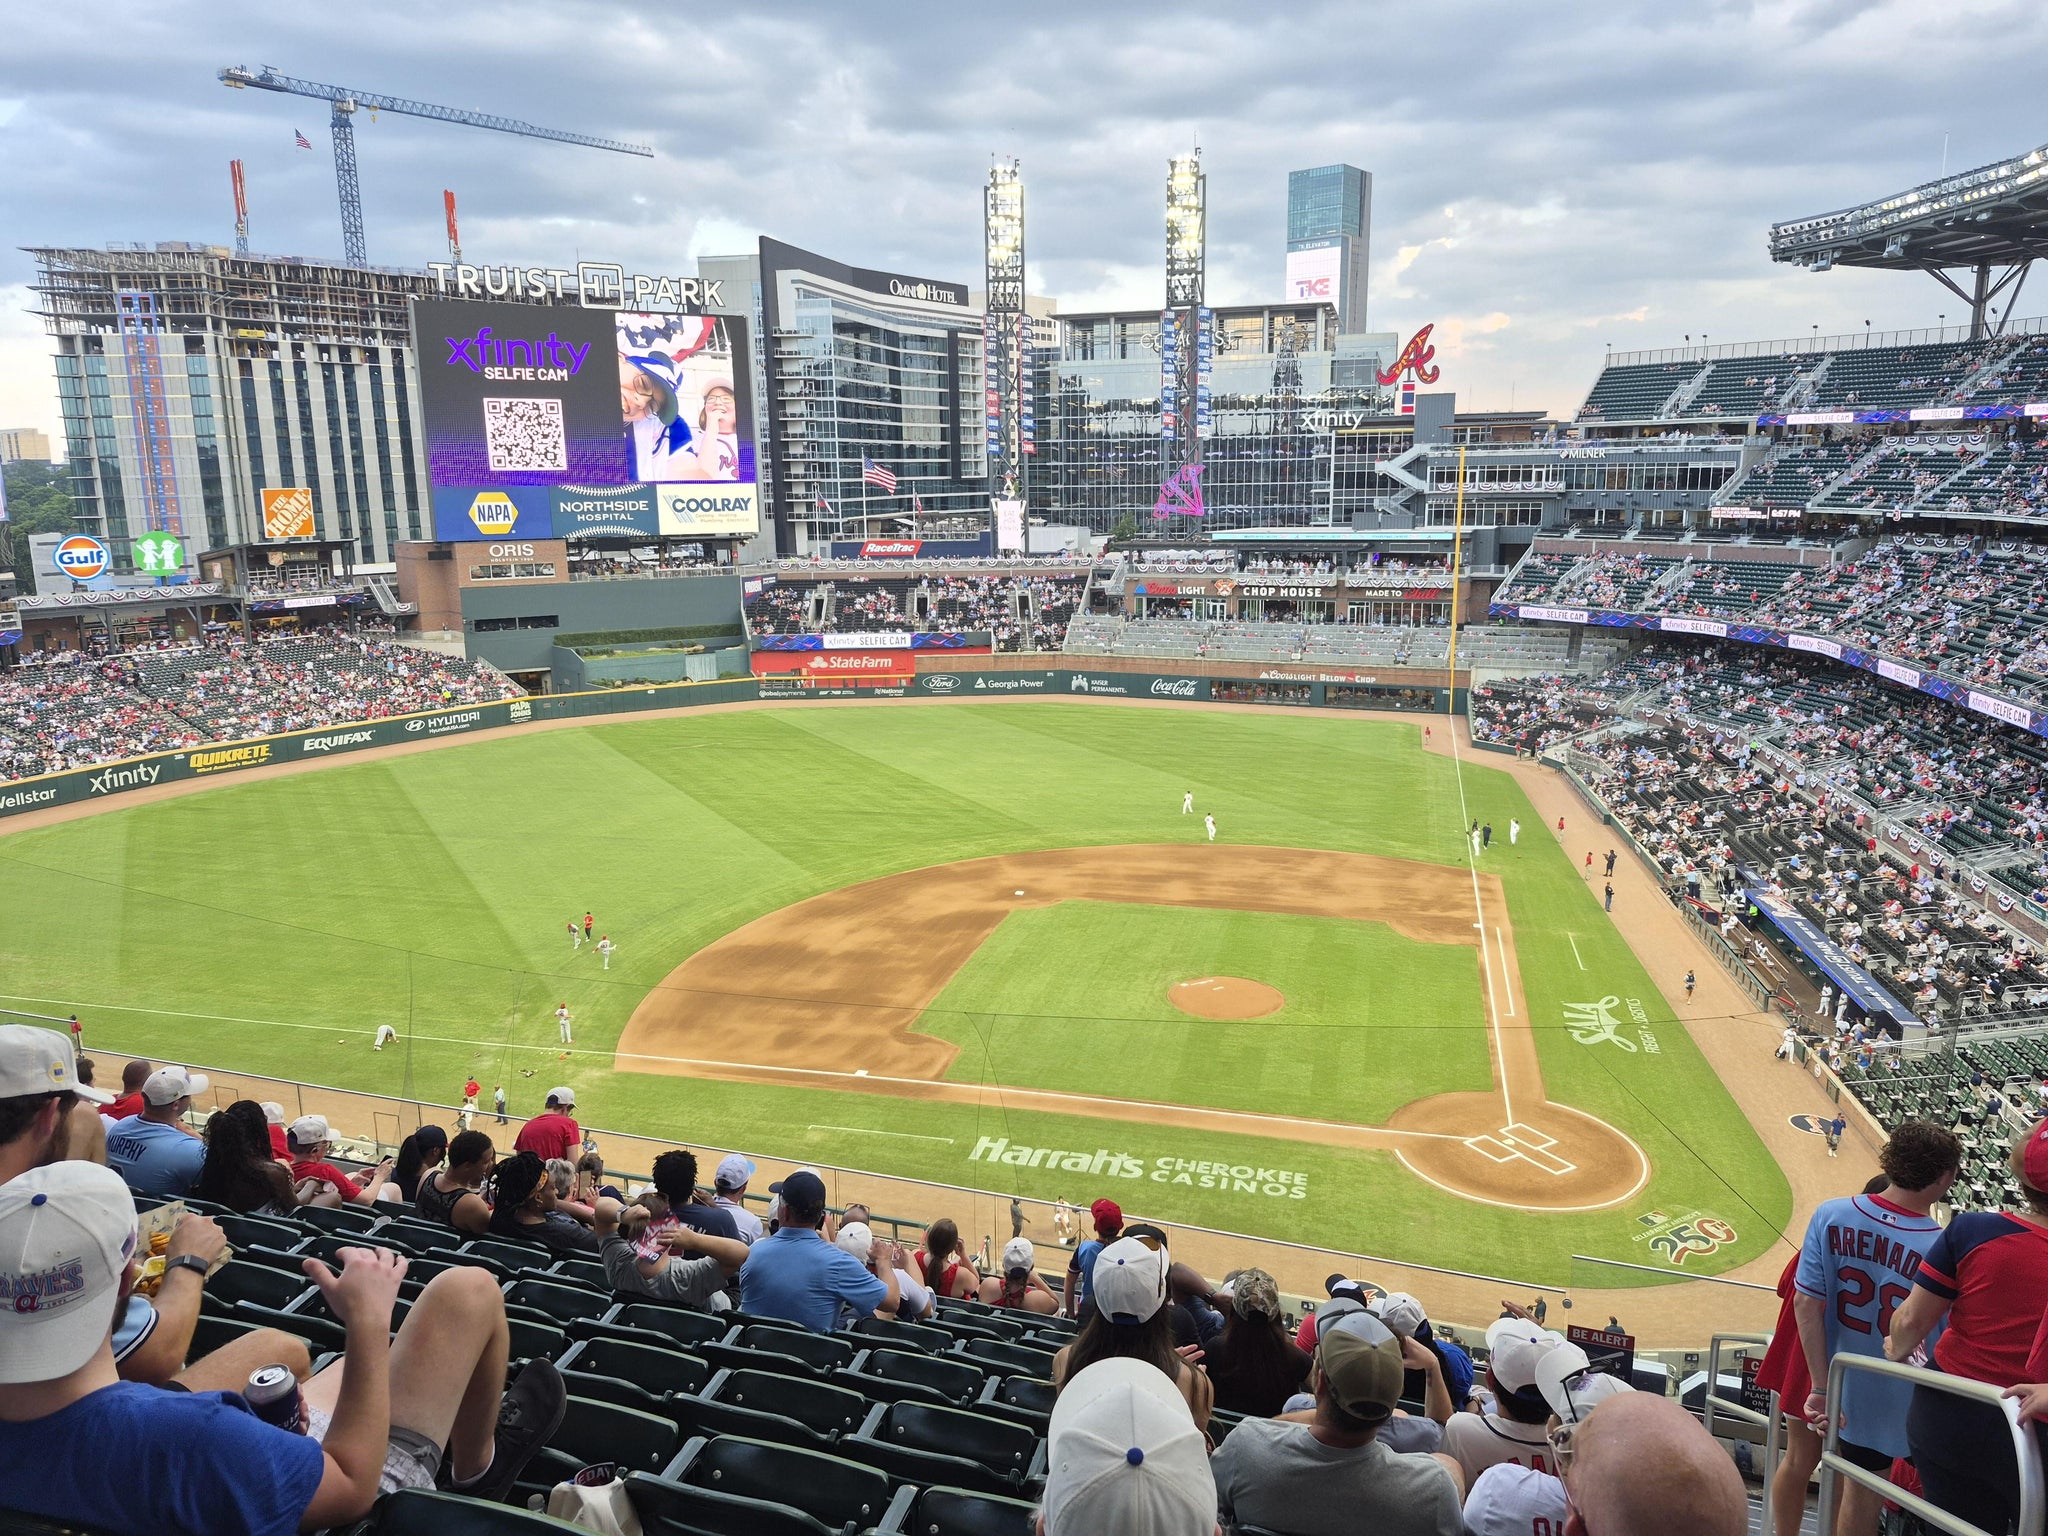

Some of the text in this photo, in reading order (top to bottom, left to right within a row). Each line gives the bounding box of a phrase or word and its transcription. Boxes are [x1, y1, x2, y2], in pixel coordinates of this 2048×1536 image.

[427, 262, 726, 307] TRUIST PARK
[889, 279, 957, 304] OMNI HOTEL
[446, 327, 591, 375] xfinity
[484, 366, 568, 382] SELFIE CAM
[1301, 410, 1364, 431] xfinity
[1569, 449, 1606, 460] MILNER
[266, 489, 310, 536] HOME
[269, 494, 288, 514] THE
[560, 500, 648, 513] NORTHSIDE
[672, 497, 751, 513] COOLRAY
[286, 505, 312, 536] DEPOT
[477, 505, 511, 522] NAPA
[577, 512, 634, 521] HOSPITAL
[489, 544, 534, 557] ORIS
[866, 543, 915, 552] RaceTrac
[58, 549, 104, 564] Gulf
[1178, 586, 1205, 594] LIGHT
[1243, 587, 1322, 598] CHOP HOUSE
[1522, 608, 1584, 621] xfinity SELFIE CAM
[1664, 620, 1725, 634] xfinity SELFIE CAM
[859, 635, 886, 646] SELFIE
[889, 635, 906, 645] CAM
[929, 678, 954, 688] Ford
[988, 679, 1044, 690] Georgia Power
[1269, 669, 1294, 680] Coors
[1320, 674, 1346, 682] BELOW
[1355, 675, 1376, 684] CHOP
[1151, 678, 1198, 697] Coca-Cola
[510, 701, 531, 711] PAPA
[510, 709, 531, 718] JOHNS
[1971, 694, 2027, 723] xfinity SELFIE CAM
[428, 711, 480, 728] HYUNDAI
[303, 730, 374, 750] EQUIFAX
[190, 744, 270, 768] QUIKRETE
[90, 763, 161, 793] xfinity
[1560, 995, 1637, 1053] SAIA
[1156, 1156, 1309, 1186] CHEROKEE
[1150, 1169, 1307, 1200] CASINOS
[1828, 1225, 1923, 1280] ARENAD
[0, 1263, 84, 1297] RAVES
[1572, 1328, 1629, 1347] BE ALERT
[1747, 1383, 1768, 1393] LEAN
